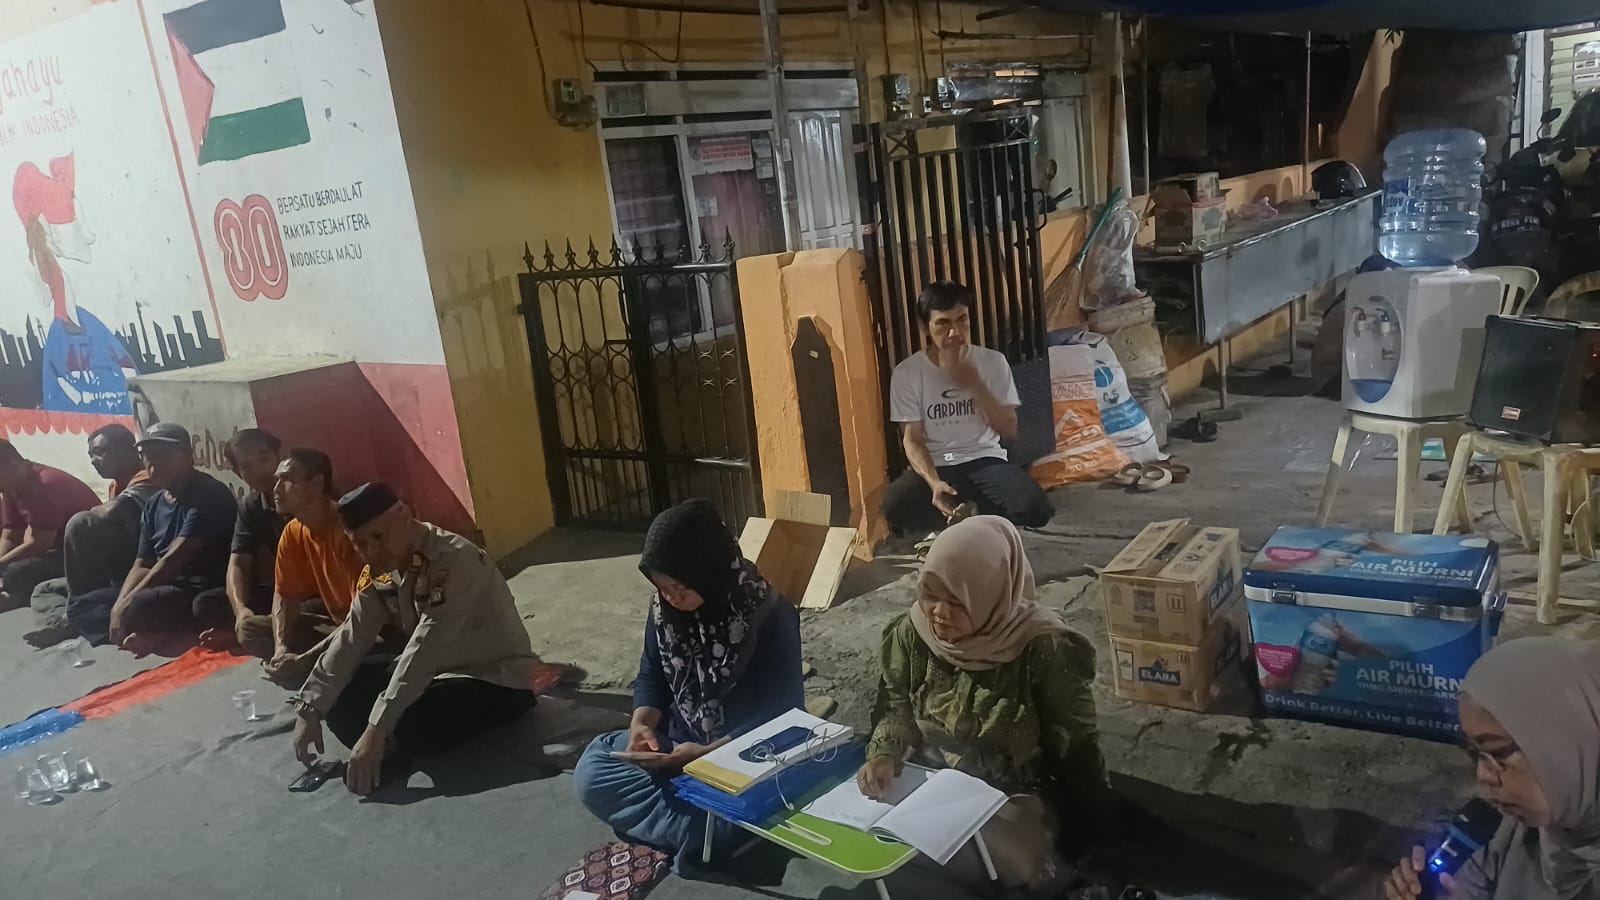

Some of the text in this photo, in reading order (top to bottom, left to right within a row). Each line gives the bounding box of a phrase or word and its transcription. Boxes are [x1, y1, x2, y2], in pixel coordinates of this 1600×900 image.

[0, 55, 64, 112] ahayu
[277, 181, 362, 214] BERSATU BERDAULAT
[283, 221, 316, 240] RAKYAT
[214, 194, 288, 302] 80
[290, 244, 362, 268] INDONESIA MAJU
[927, 398, 976, 419] CARDINA
[1351, 561, 1473, 577] AIR MURNI
[1391, 558, 1438, 567] PILIH
[1356, 667, 1464, 691] AIR MURN
[1390, 660, 1434, 674] PILIH
[1265, 694, 1305, 709] Drink
[1366, 710, 1401, 722] Live
